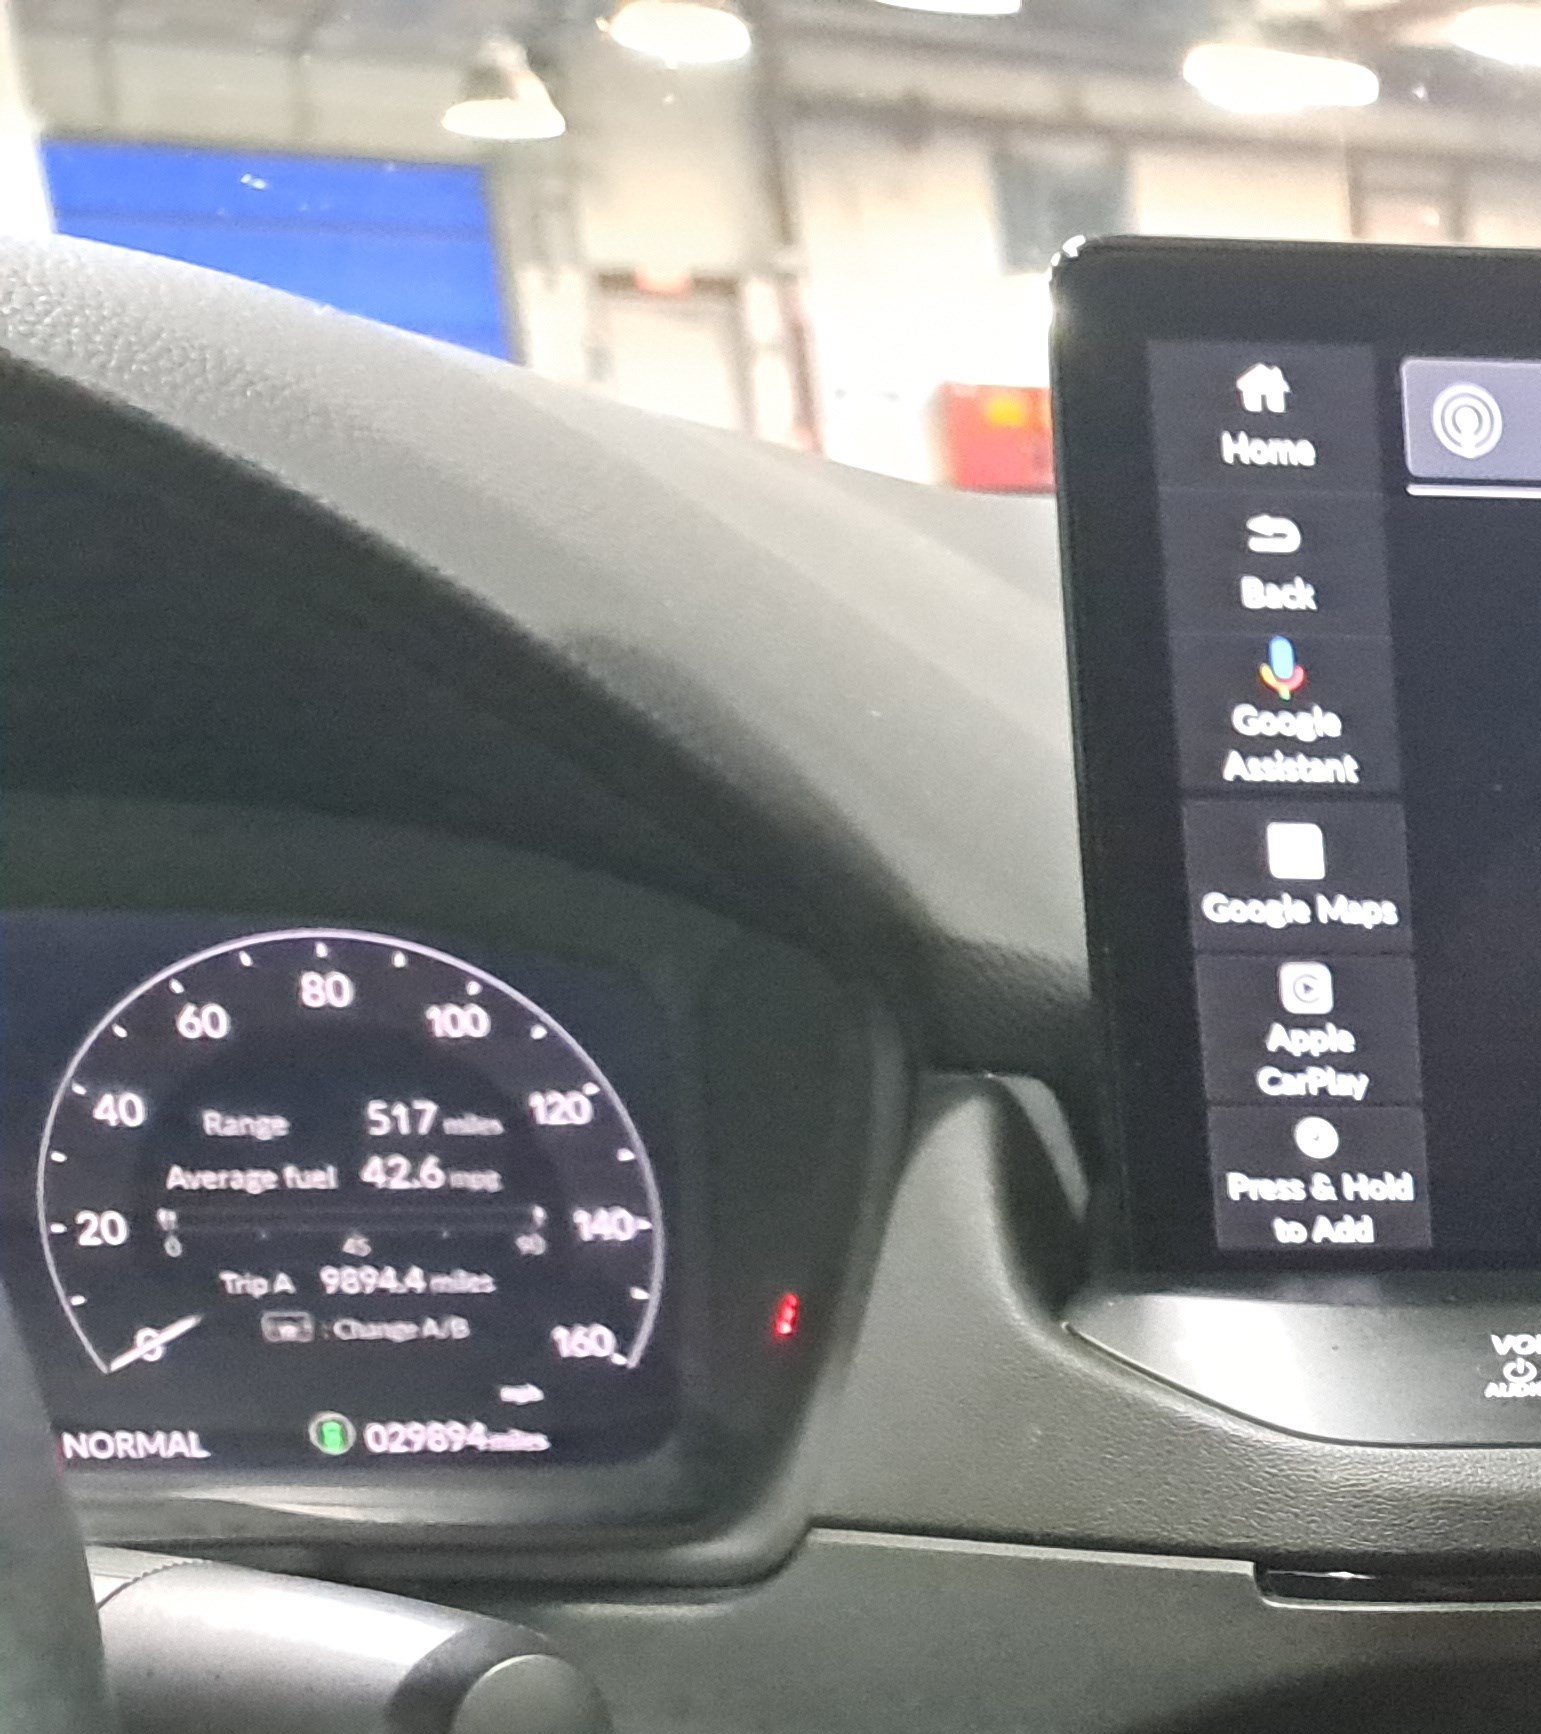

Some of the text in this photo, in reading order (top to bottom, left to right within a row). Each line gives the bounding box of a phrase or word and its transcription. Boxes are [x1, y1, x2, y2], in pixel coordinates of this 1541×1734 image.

[1221, 430, 1316, 467] Home
[1240, 575, 1317, 611] Back
[1231, 703, 1342, 742] Google
[1222, 750, 1360, 784] Assistant
[1202, 891, 1399, 929] Google Maps
[301, 972, 354, 1007] 80
[176, 1003, 231, 1039] 60
[425, 1003, 491, 1038] 100
[1265, 1022, 1356, 1057] Apple
[1255, 1065, 1370, 1100] CarPlay
[92, 1092, 148, 1128] 40
[202, 1109, 291, 1140] Range
[366, 1099, 439, 1136] 517
[528, 1090, 593, 1125] 120
[165, 1164, 278, 1194] Average
[283, 1163, 339, 1189] fuel
[359, 1154, 446, 1190] 42.6
[1226, 1171, 1414, 1204] Press & Hold
[75, 1210, 128, 1246] 20
[573, 1206, 638, 1241] 140
[1273, 1214, 1375, 1245] to Add
[219, 1270, 269, 1299] Trip
[273, 1272, 296, 1294] A
[319, 1265, 427, 1294] 9894.4
[551, 1323, 617, 1358] 160
[61, 1430, 212, 1459] NORMAL
[364, 1420, 487, 1453] 029894
